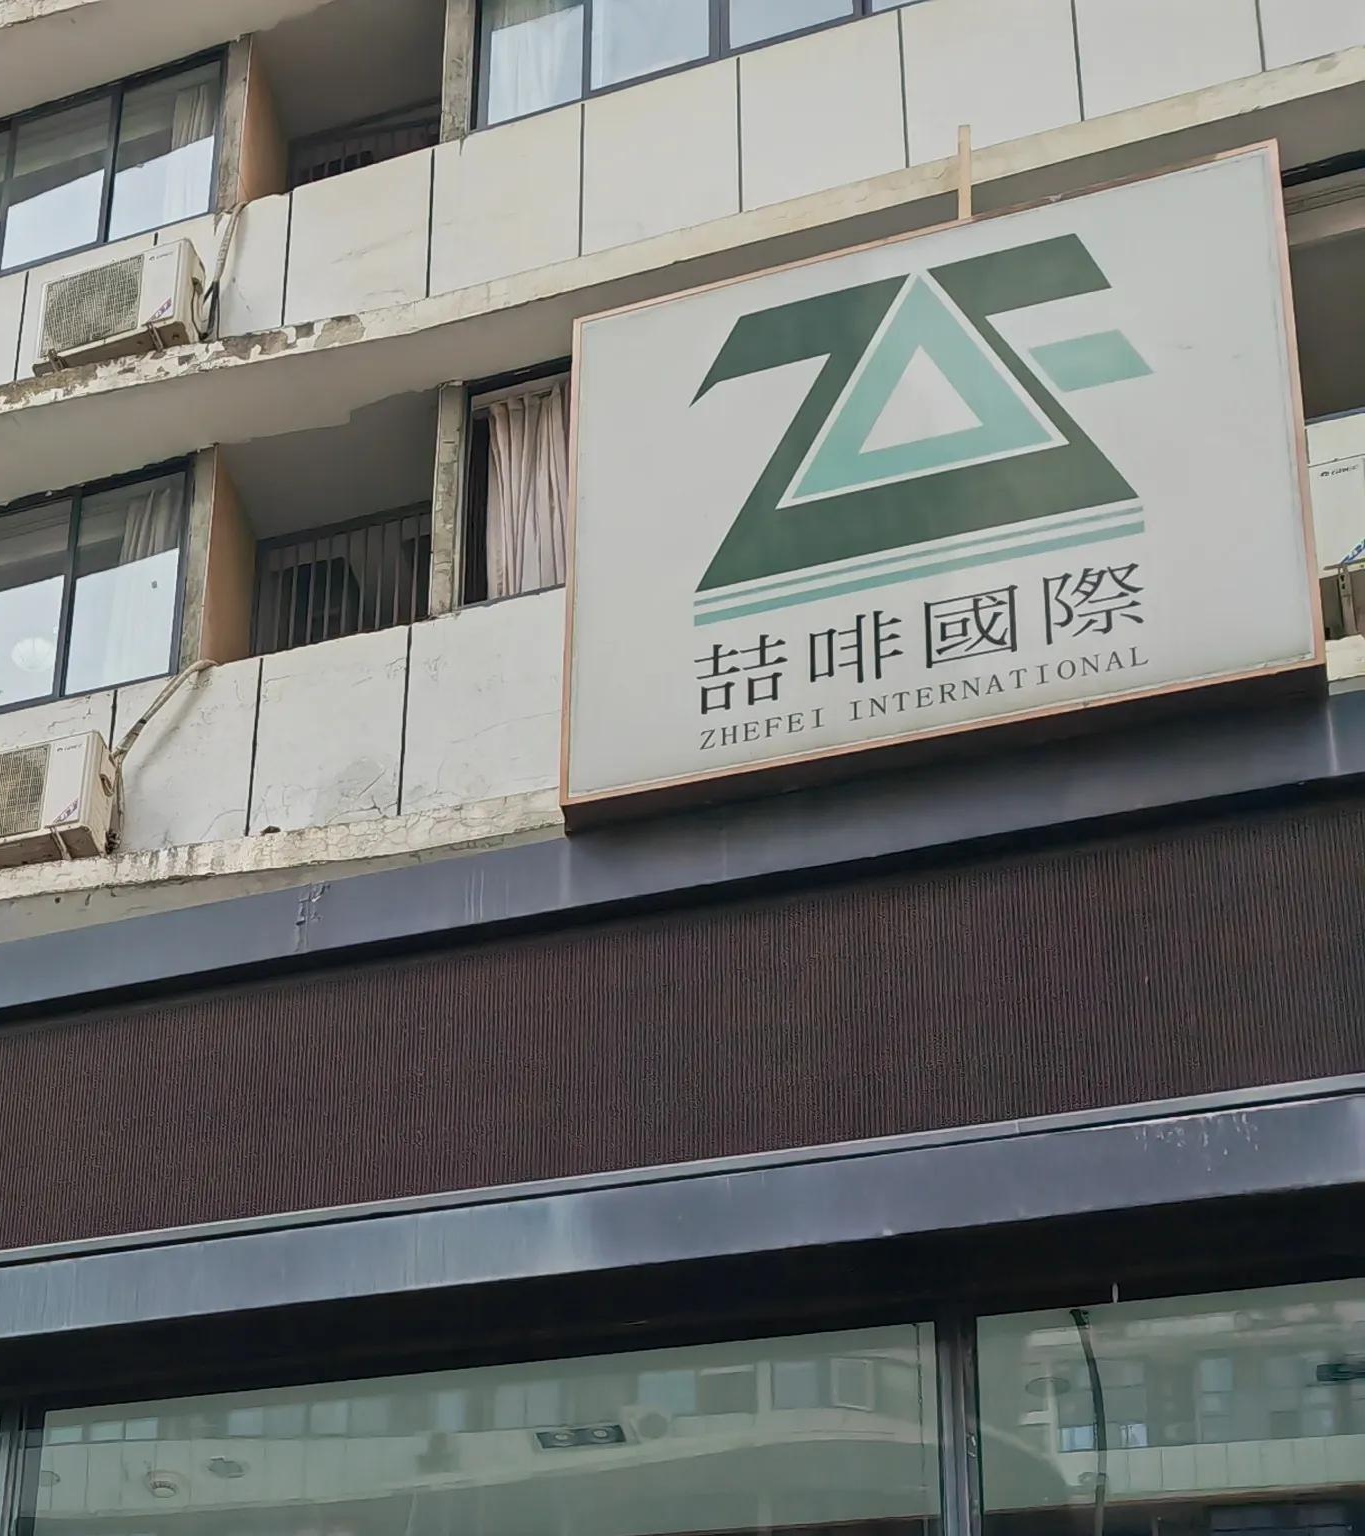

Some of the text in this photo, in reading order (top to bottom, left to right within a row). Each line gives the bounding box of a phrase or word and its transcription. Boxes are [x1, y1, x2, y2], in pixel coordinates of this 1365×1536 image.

[694, 563, 1145, 714] 喆啡國際
[700, 647, 1149, 750] ZHEFEI INTERNATIONAL
